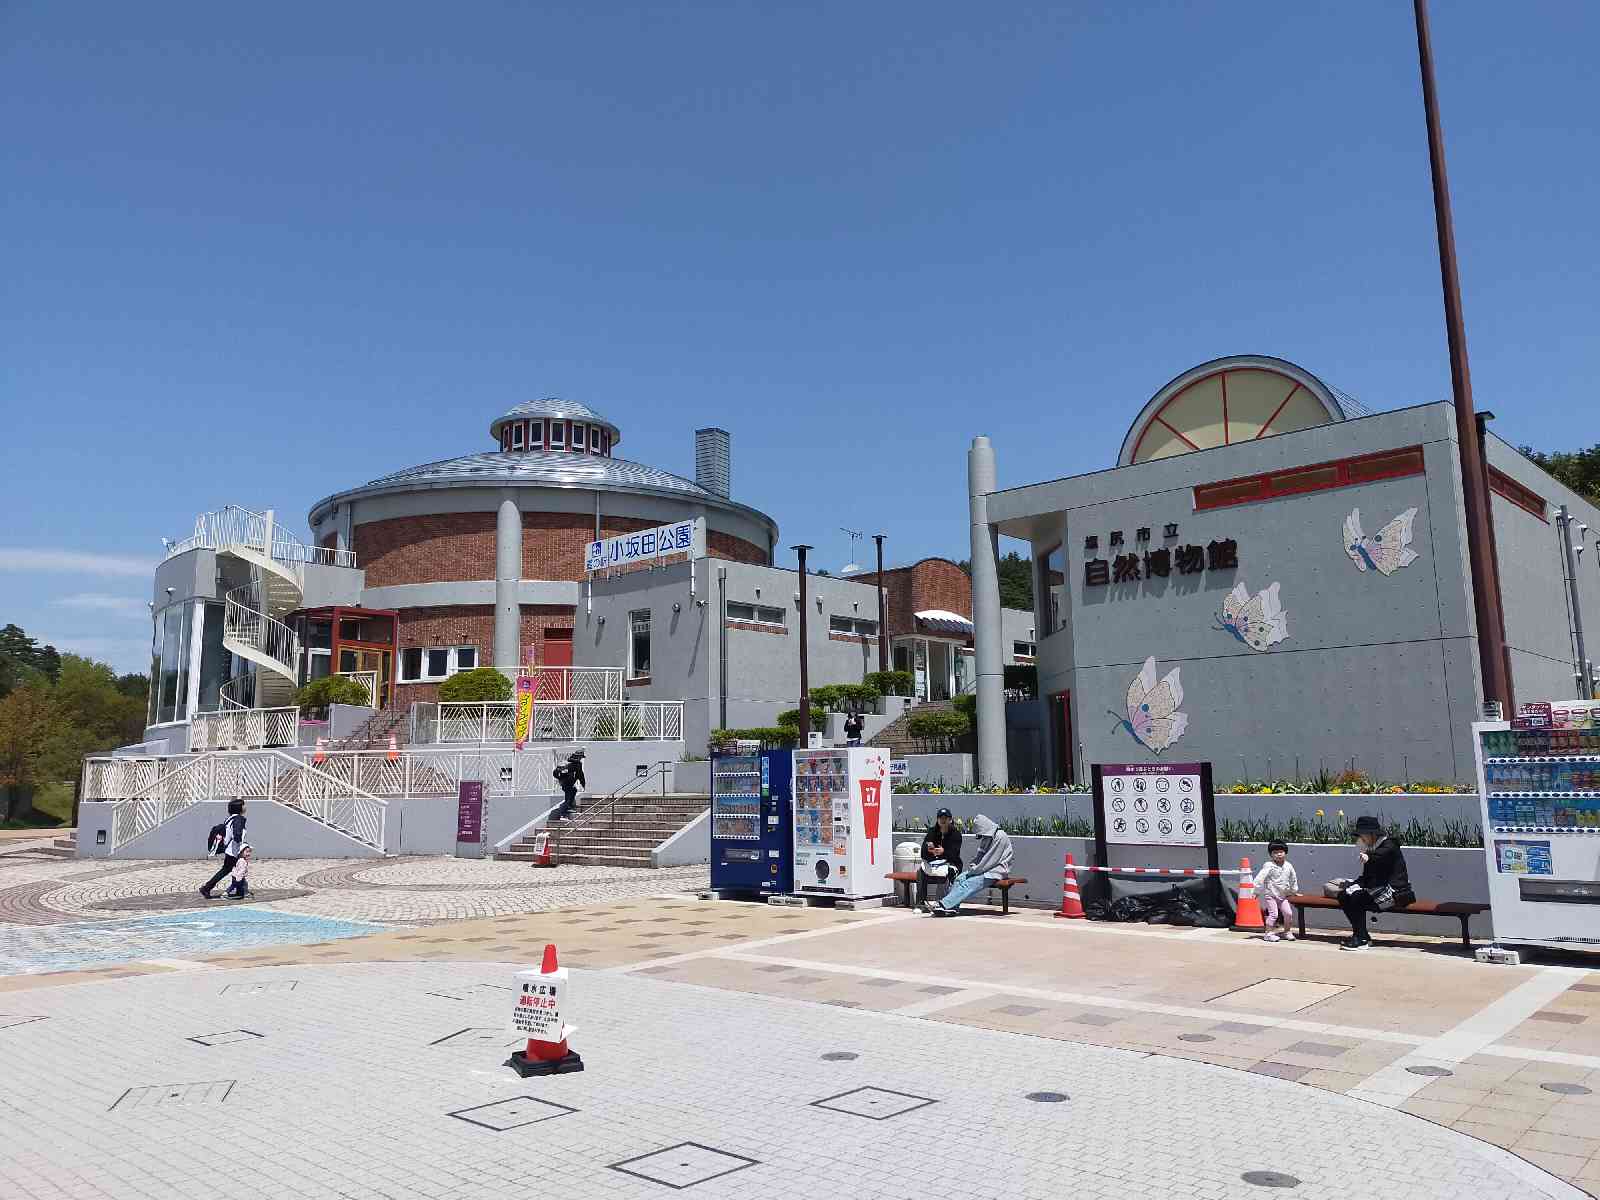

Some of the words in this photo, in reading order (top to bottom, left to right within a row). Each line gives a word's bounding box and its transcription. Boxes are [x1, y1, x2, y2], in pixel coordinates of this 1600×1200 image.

[610, 524, 691, 561] 小坂田公園
[1085, 538, 1239, 586] 自然博物館
[519, 995, 556, 1009] 運転停止中
